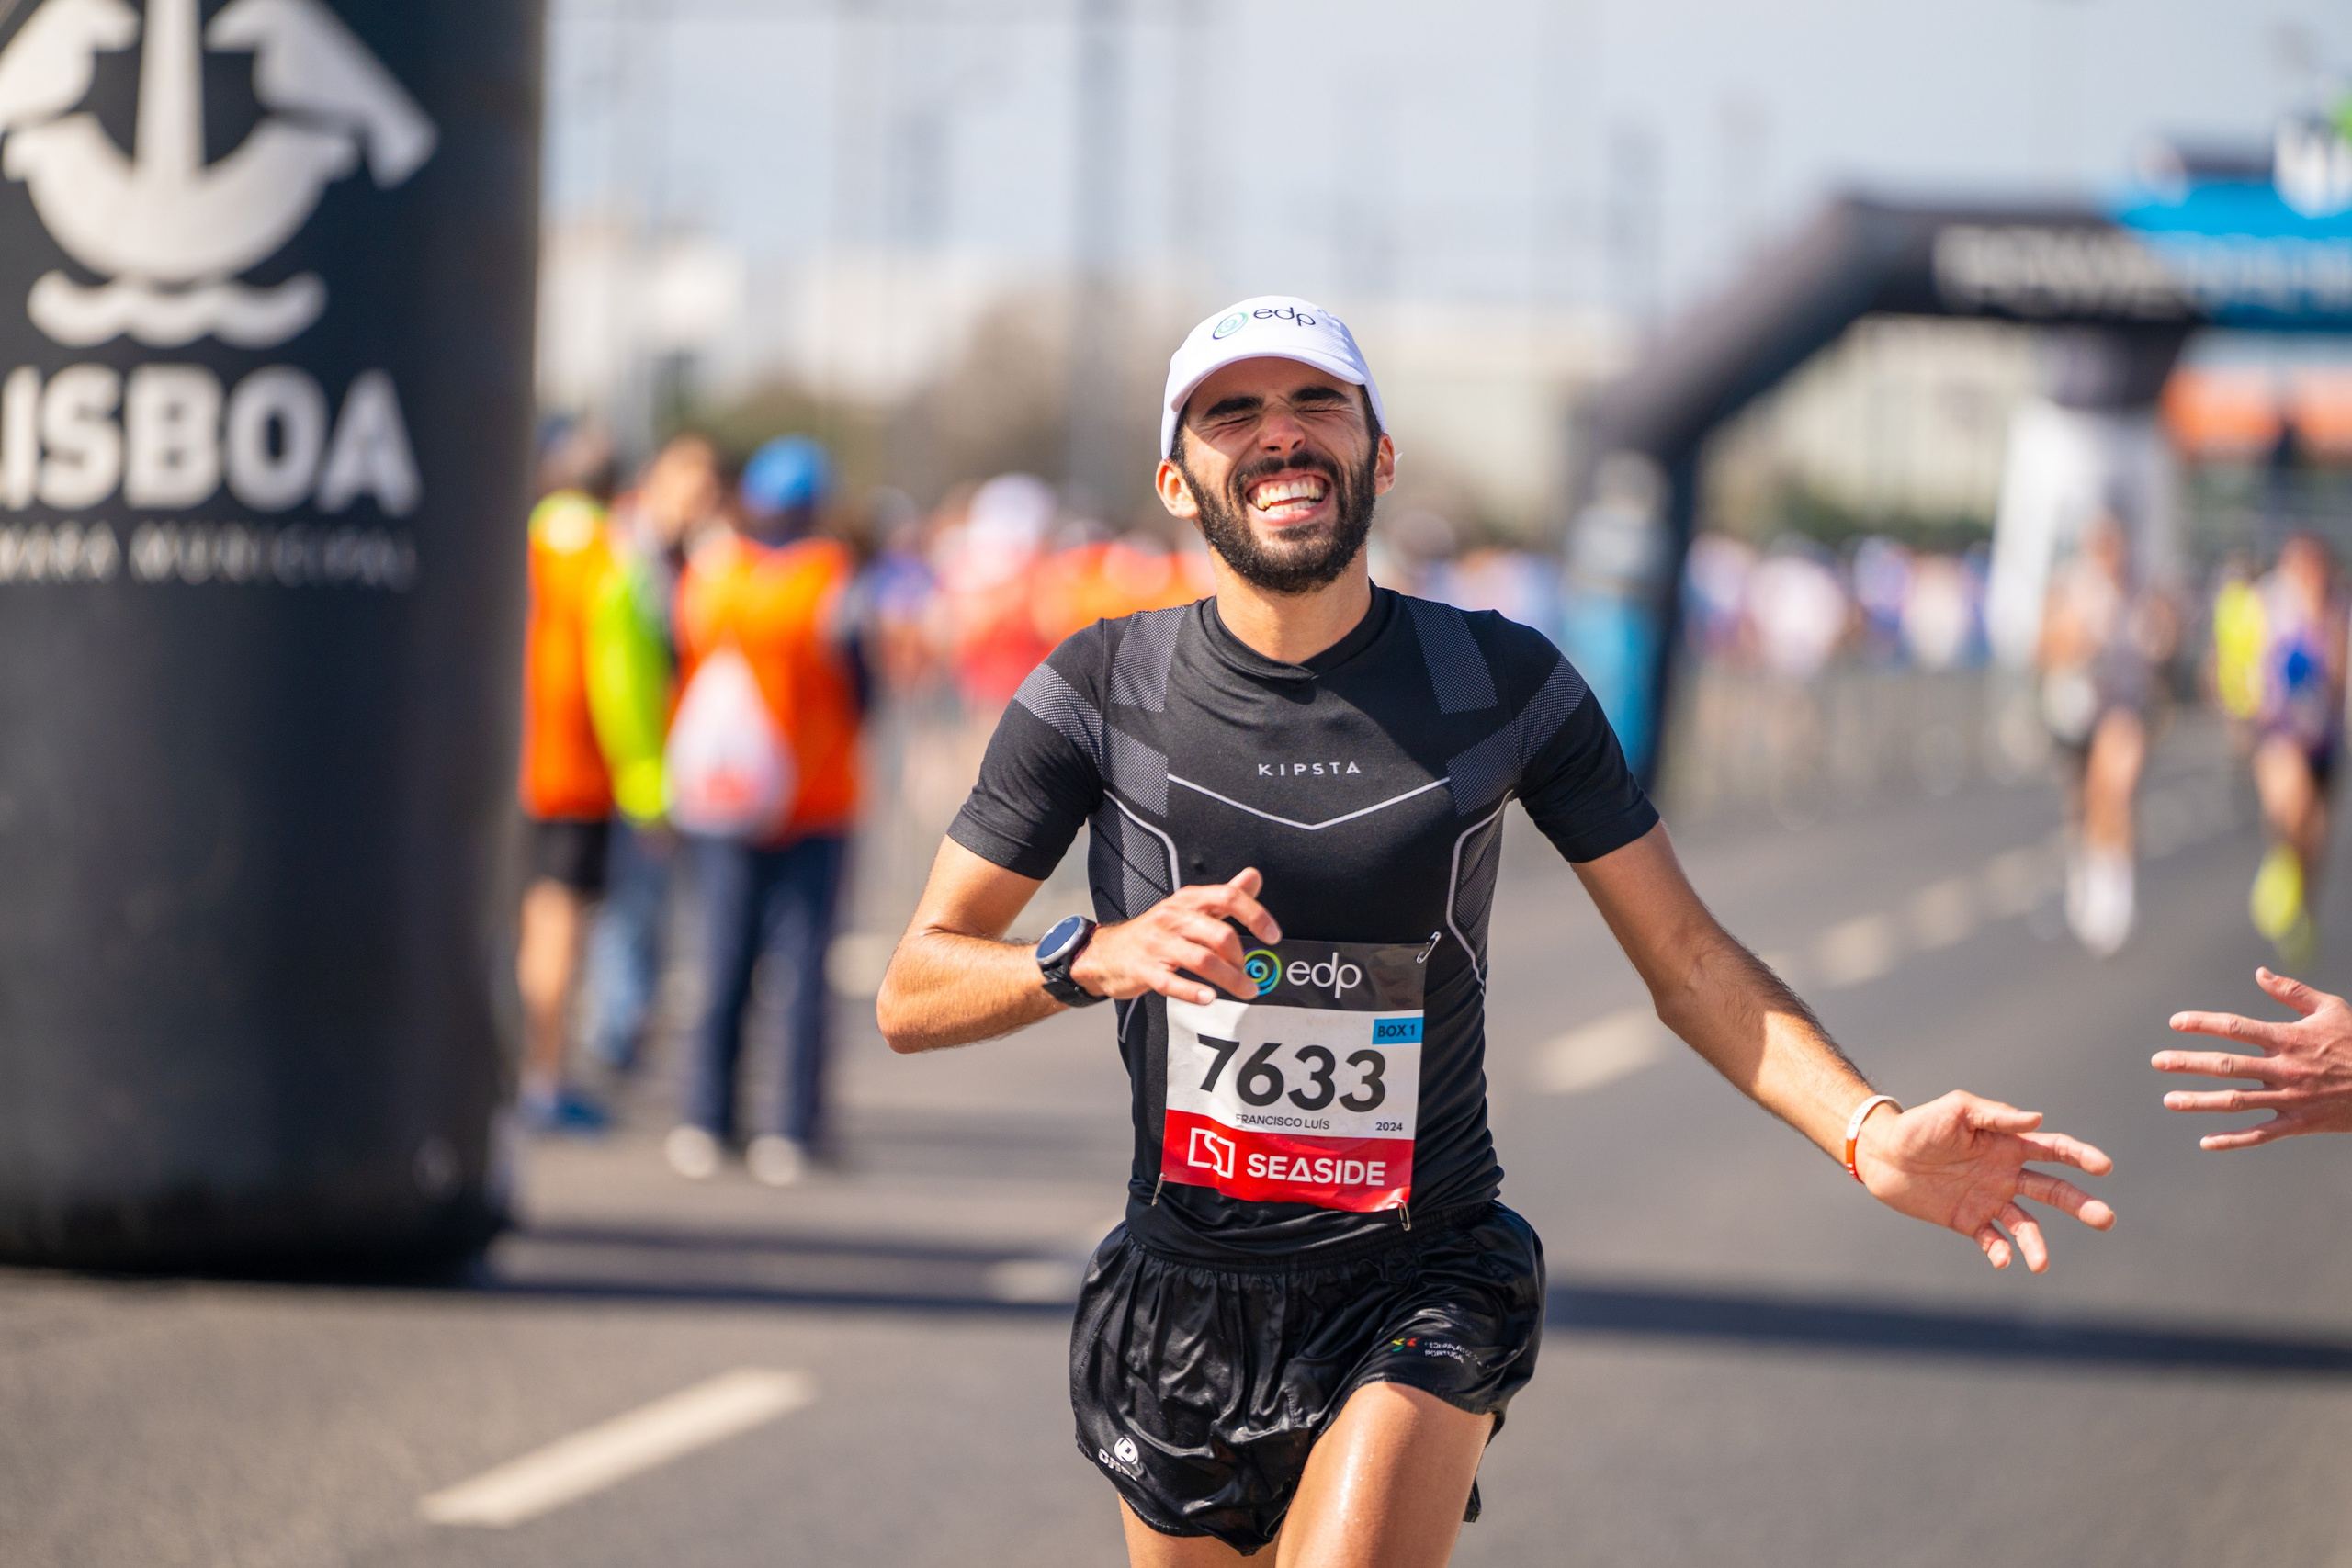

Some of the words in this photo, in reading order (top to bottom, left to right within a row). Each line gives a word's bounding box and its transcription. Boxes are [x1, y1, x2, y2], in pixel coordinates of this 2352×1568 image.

[1253, 307, 1316, 327] edp
[0, 363, 421, 515] ISBOA
[1258, 761, 1361, 776] KIPSTA
[1286, 952, 1363, 999] edp
[1378, 1024, 1407, 1038] BOX
[1409, 1023, 1416, 1036] 1
[1196, 1032, 1386, 1112] 7633
[1236, 1113, 1303, 1128] FRANCISCO
[1304, 1118, 1330, 1130] LUÍS
[1375, 1122, 1403, 1132] 2024
[1246, 1153, 1386, 1186] SEASIDE
